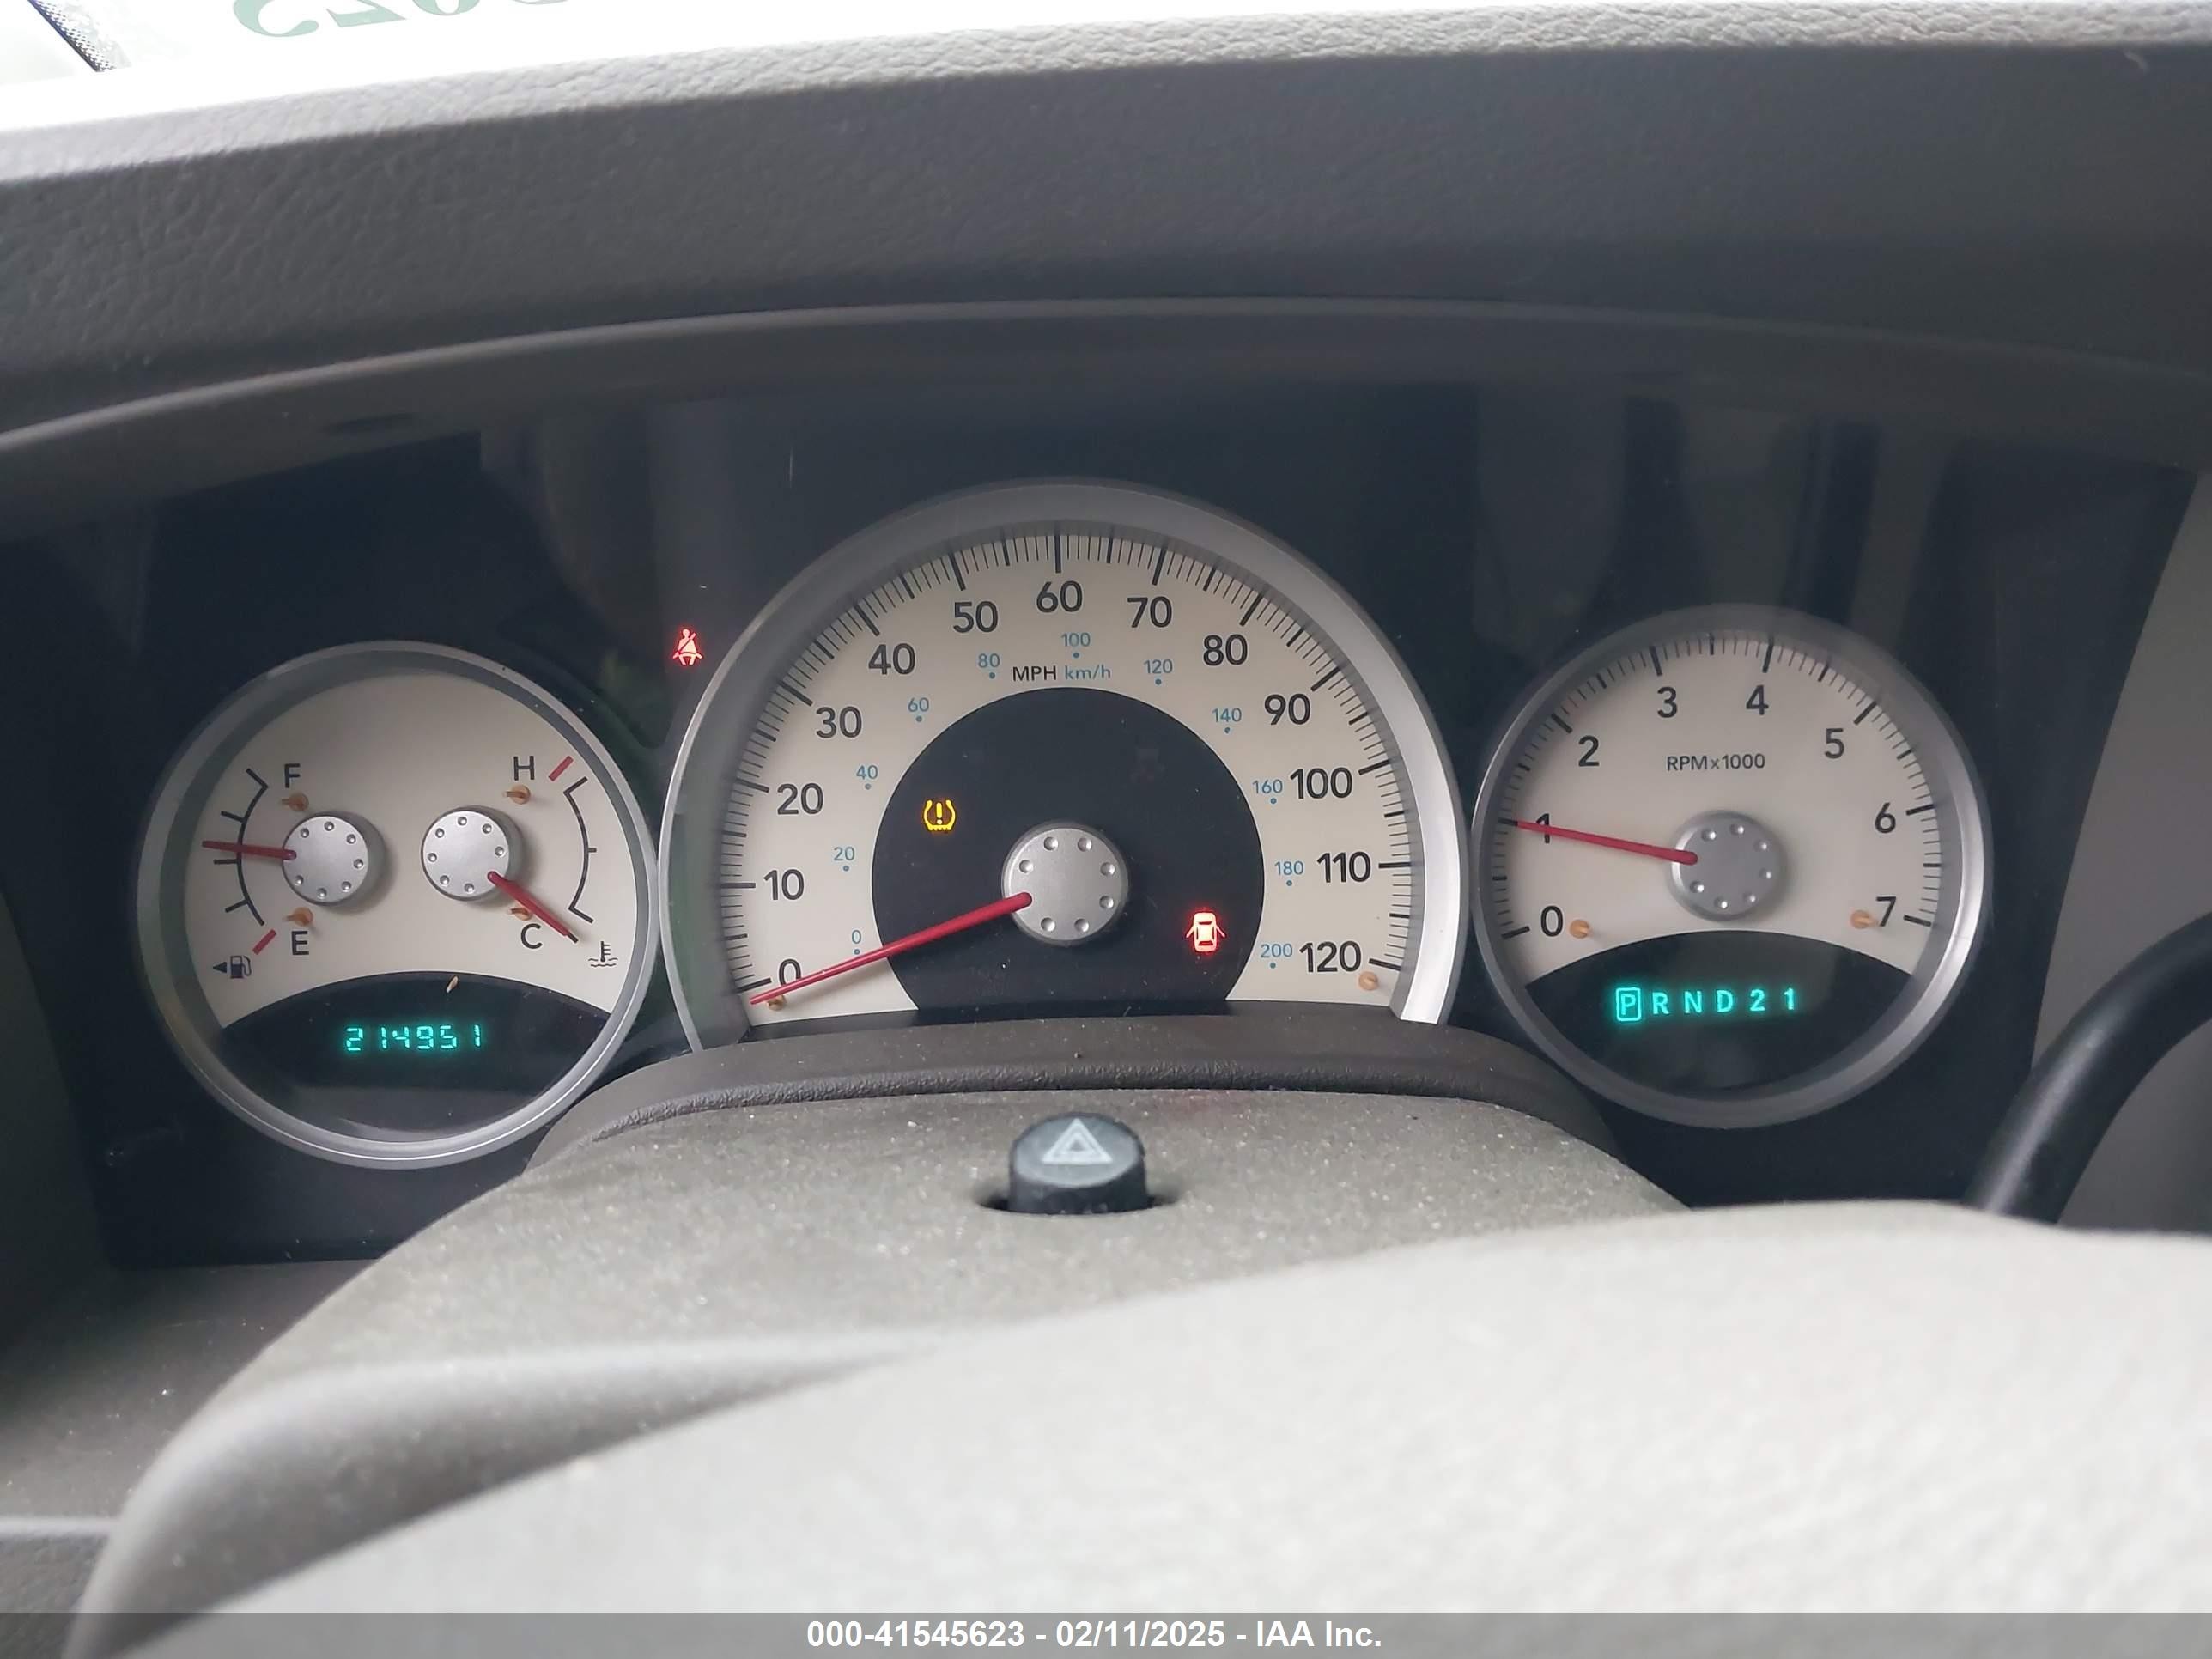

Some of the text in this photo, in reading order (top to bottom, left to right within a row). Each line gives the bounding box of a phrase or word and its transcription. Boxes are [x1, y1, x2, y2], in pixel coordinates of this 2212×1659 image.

[1036, 580, 1082, 612] 60
[953, 601, 998, 633] 50
[1127, 596, 1172, 628] 70
[1061, 633, 1091, 647] 100
[1204, 634, 1247, 665] 80
[869, 643, 915, 674] 40
[979, 653, 1000, 668] 80
[1013, 665, 1110, 681] MPH km/h
[1145, 659, 1172, 673] 120
[908, 697, 929, 712] 60
[1212, 708, 1242, 722] 140
[1264, 694, 1310, 726] 90
[1657, 687, 1677, 718] 3
[1747, 685, 1769, 715] 4
[816, 706, 861, 738] 30
[1579, 735, 1599, 767] 2
[1825, 728, 1844, 759] 5
[284, 763, 300, 788] F
[514, 756, 534, 781] H
[856, 765, 878, 780] 40
[1291, 768, 1352, 799] 100
[777, 783, 823, 815] 20
[1253, 780, 1282, 793] 160
[1536, 813, 1553, 843] 1
[1875, 803, 1896, 833] 6
[834, 847, 854, 860] 20
[1275, 861, 1304, 875] 180
[1317, 852, 1370, 883] 110
[763, 869, 804, 900] 10
[1541, 906, 1563, 937] 0
[1876, 896, 1896, 927] 7
[292, 931, 309, 955] E
[521, 926, 543, 950] C
[852, 930, 861, 944] 0
[1261, 944, 1292, 957] 200
[1300, 941, 1361, 972] 120
[778, 959, 801, 988] 0
[1653, 993, 1669, 1014] R
[1685, 991, 1702, 1013] N
[1717, 990, 1733, 1012] D
[1750, 989, 1765, 1011] 2
[1784, 988, 1794, 1010] 1
[347, 1025, 480, 1051] 214951
